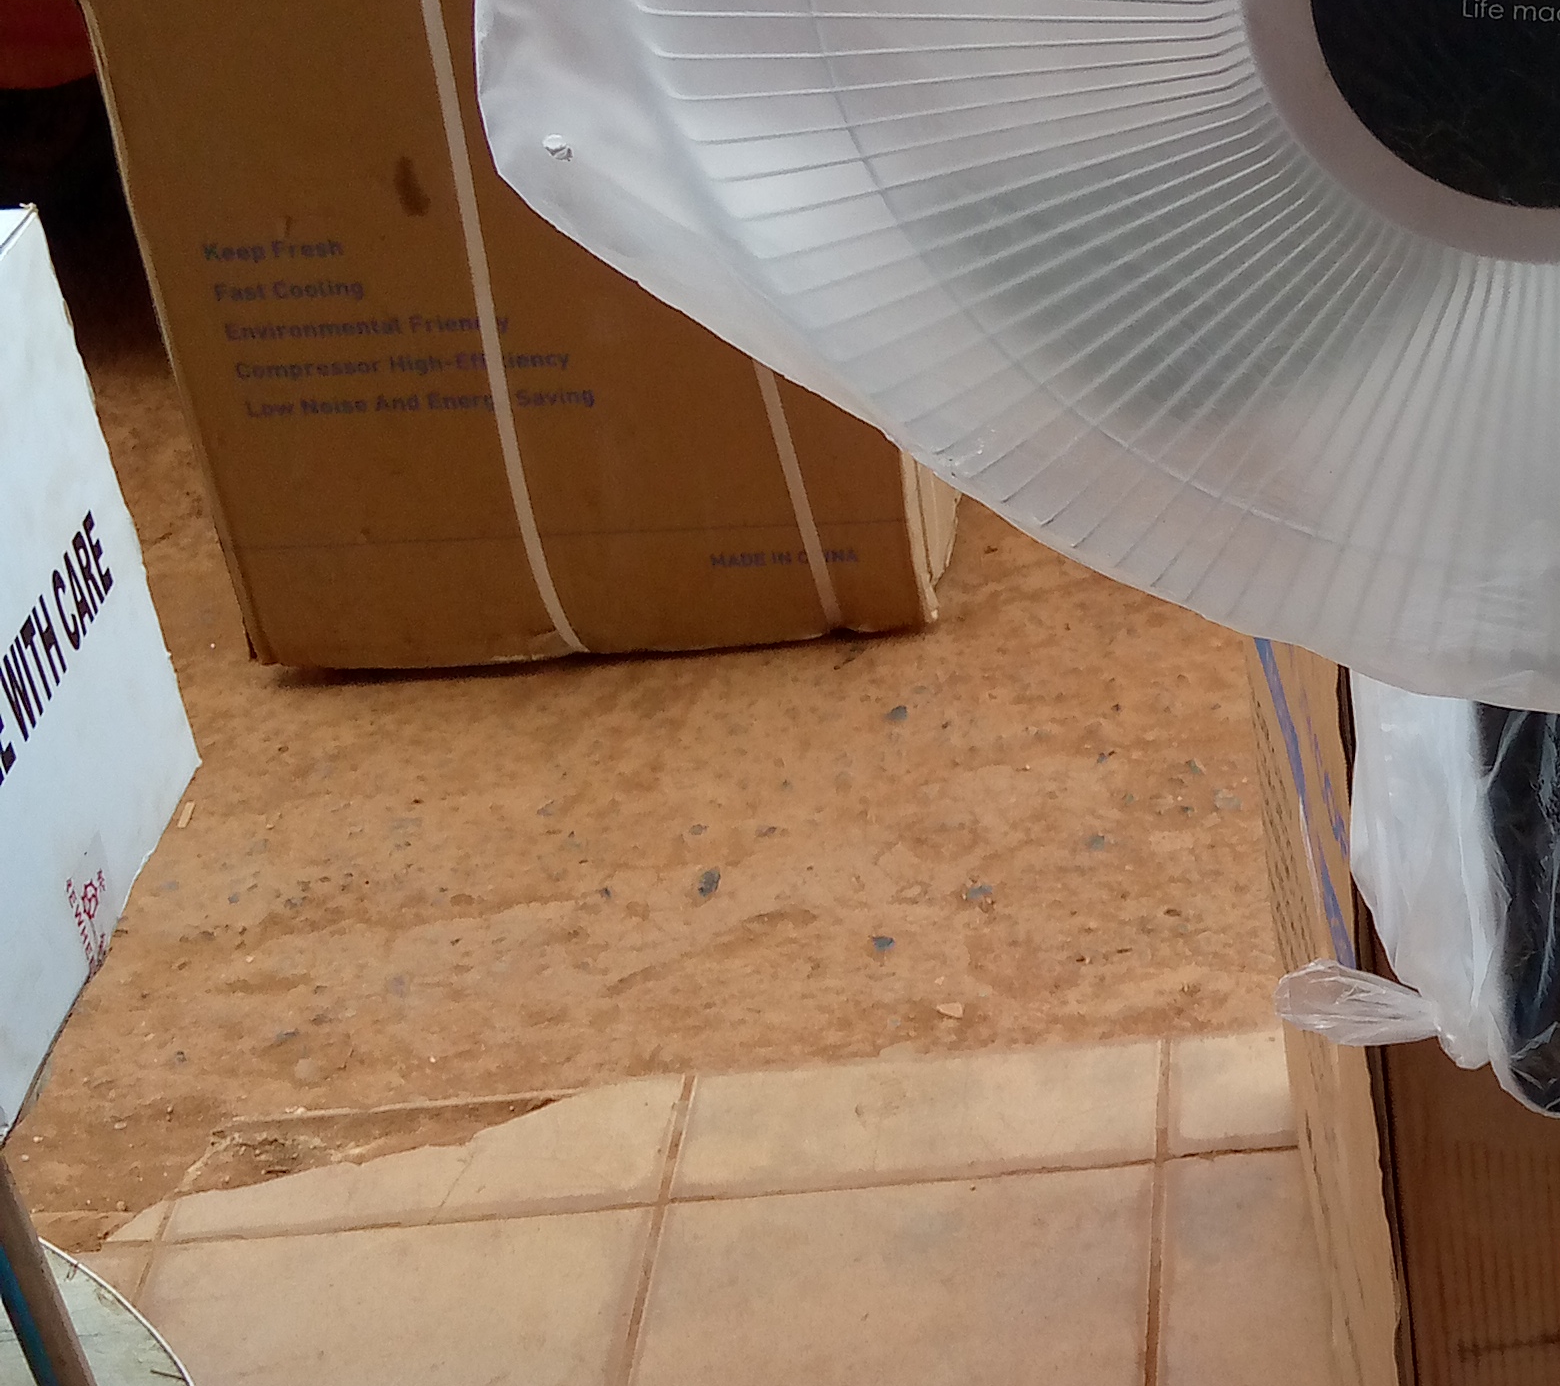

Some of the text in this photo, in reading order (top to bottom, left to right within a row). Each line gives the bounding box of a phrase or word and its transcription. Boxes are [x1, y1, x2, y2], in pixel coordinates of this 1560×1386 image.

[204, 240, 344, 263] Keep Fresh
[214, 281, 365, 301] Fast Cooling
[226, 318, 402, 341] Environmental
[235, 361, 380, 382] Compressor
[245, 389, 595, 418] Low Noise And Energ Saving
[709, 546, 859, 568] MADE IN CINA
[0, 594, 68, 742] WITH
[52, 509, 114, 651] CARE
